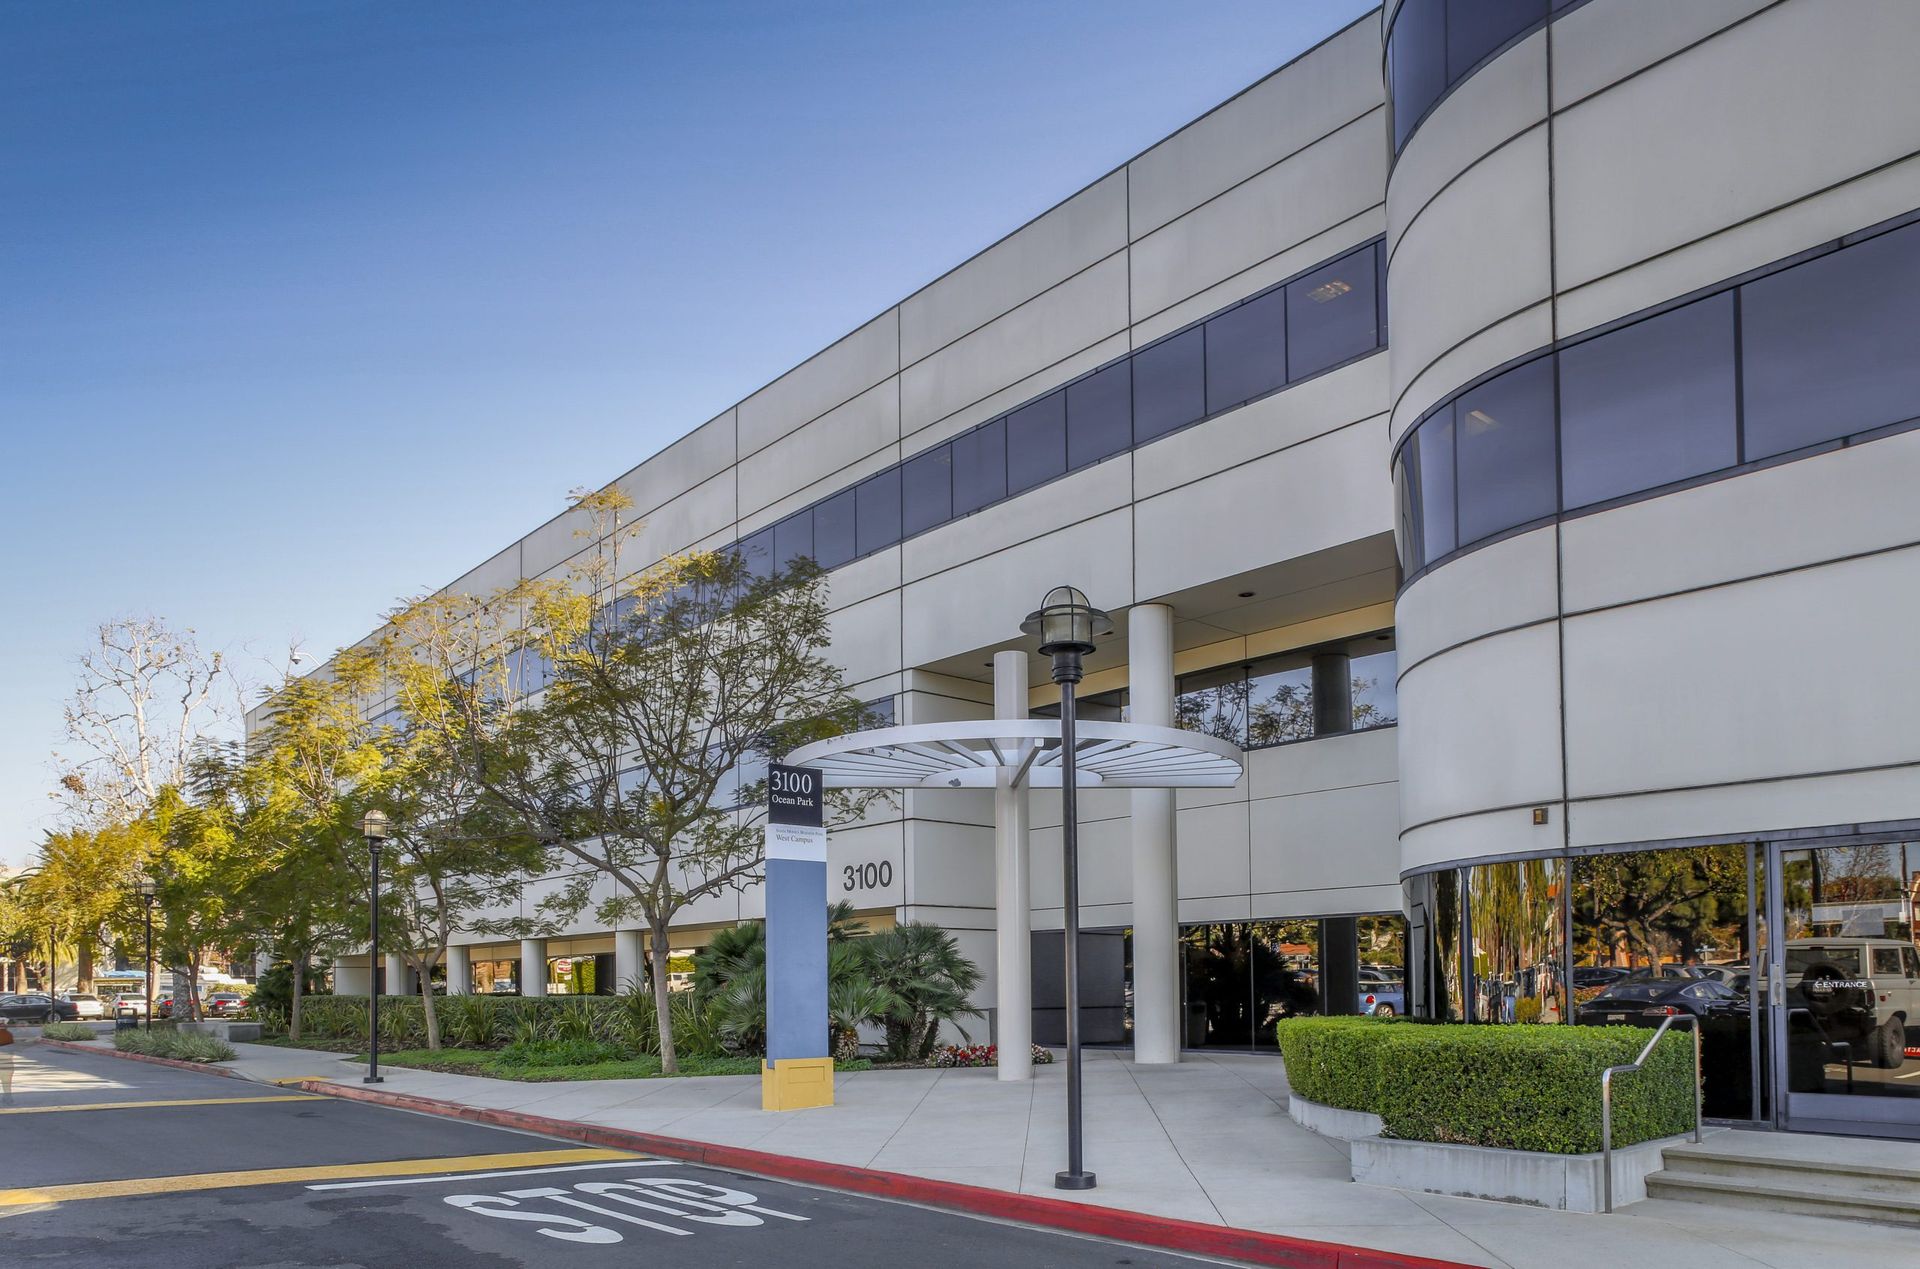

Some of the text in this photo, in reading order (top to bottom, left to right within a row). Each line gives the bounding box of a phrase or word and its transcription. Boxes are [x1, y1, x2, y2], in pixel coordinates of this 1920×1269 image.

[771, 771, 812, 794] 3100
[771, 794, 814, 807] Ocean Park
[776, 833, 814, 844] West Campus
[843, 860, 893, 891] 3100
[443, 1177, 811, 1244] STOP
